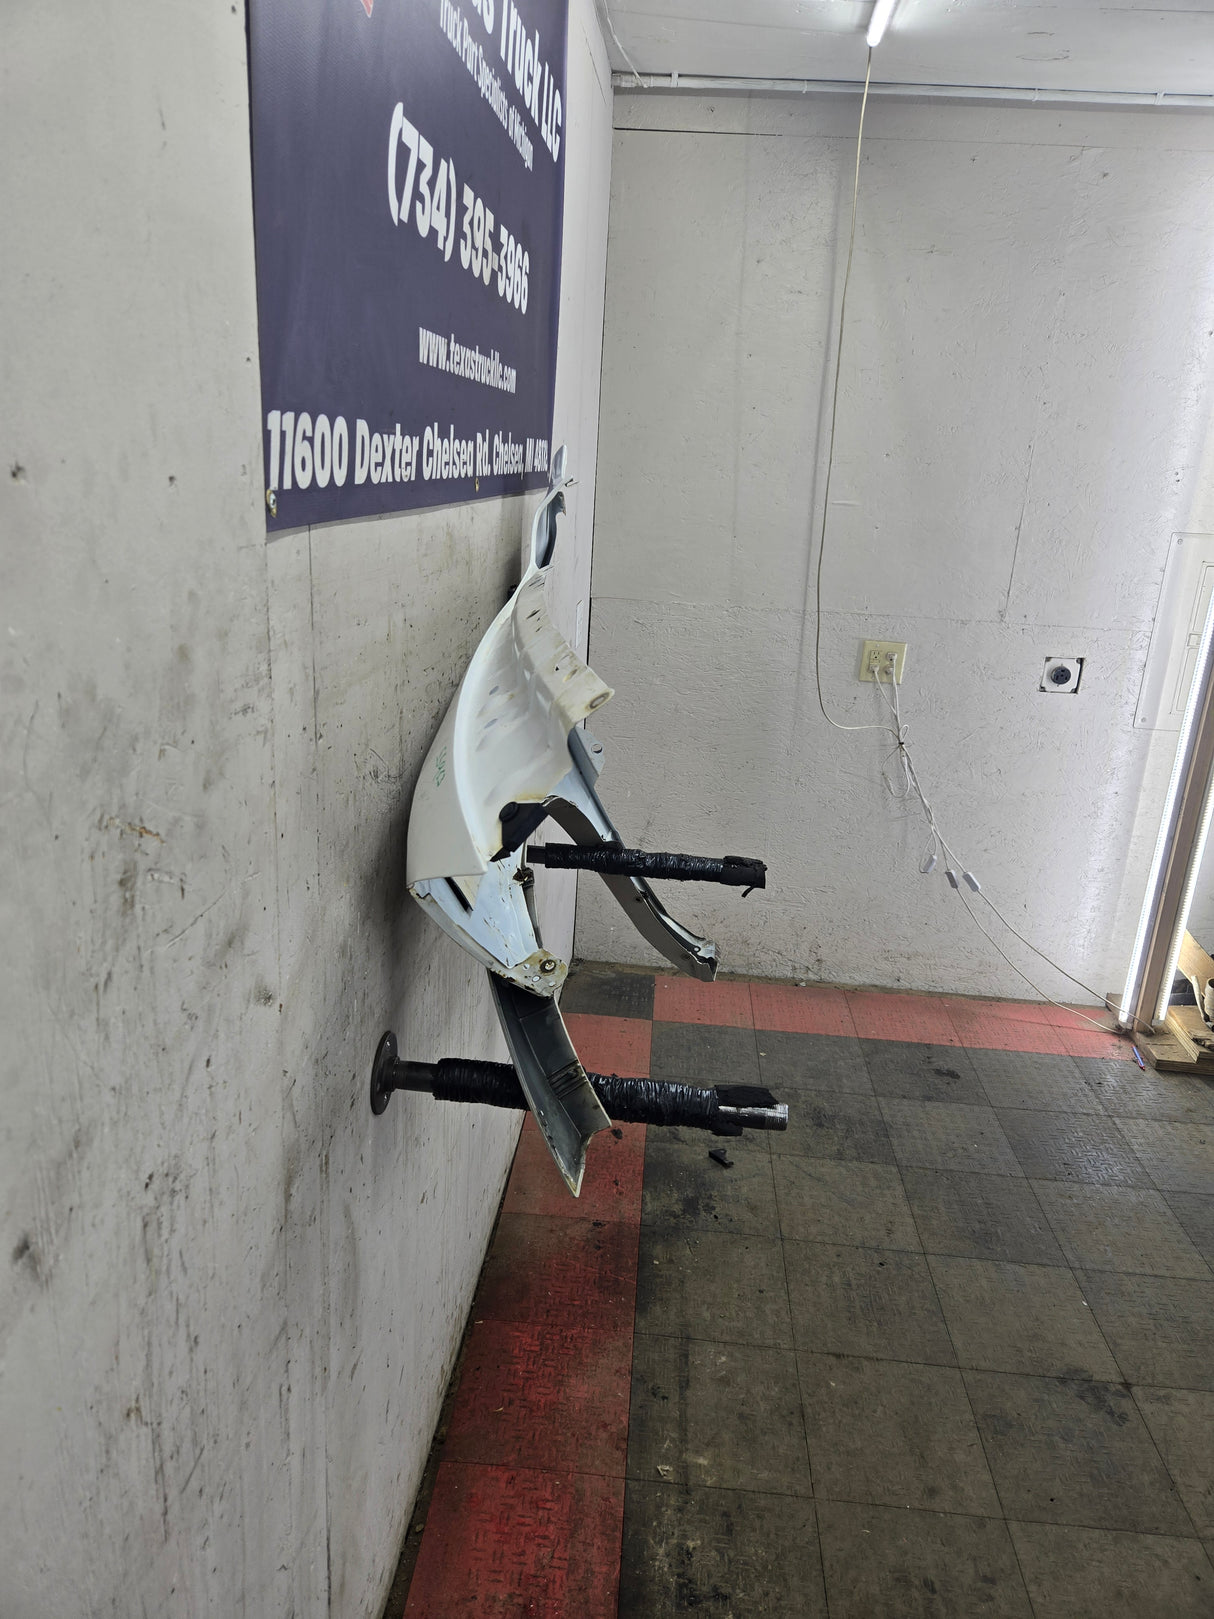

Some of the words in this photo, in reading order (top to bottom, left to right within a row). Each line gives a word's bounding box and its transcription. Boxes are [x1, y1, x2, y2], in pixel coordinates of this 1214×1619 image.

[462, 17, 479, 82] Part
[477, 44, 508, 130] Specialists
[513, 108, 534, 171] Michigan
[541, 61, 562, 163] LLC
[387, 102, 456, 262] (734)
[460, 183, 530, 315] 395-3966
[418, 327, 517, 394] www.texastruckllc.com
[267, 409, 349, 490] 11600
[354, 418, 420, 485] Dexter
[422, 421, 474, 481] Chelsea
[475, 428, 491, 477] Rd.
[492, 430, 524, 480] Chelsea,
[525, 438, 535, 473] MI
